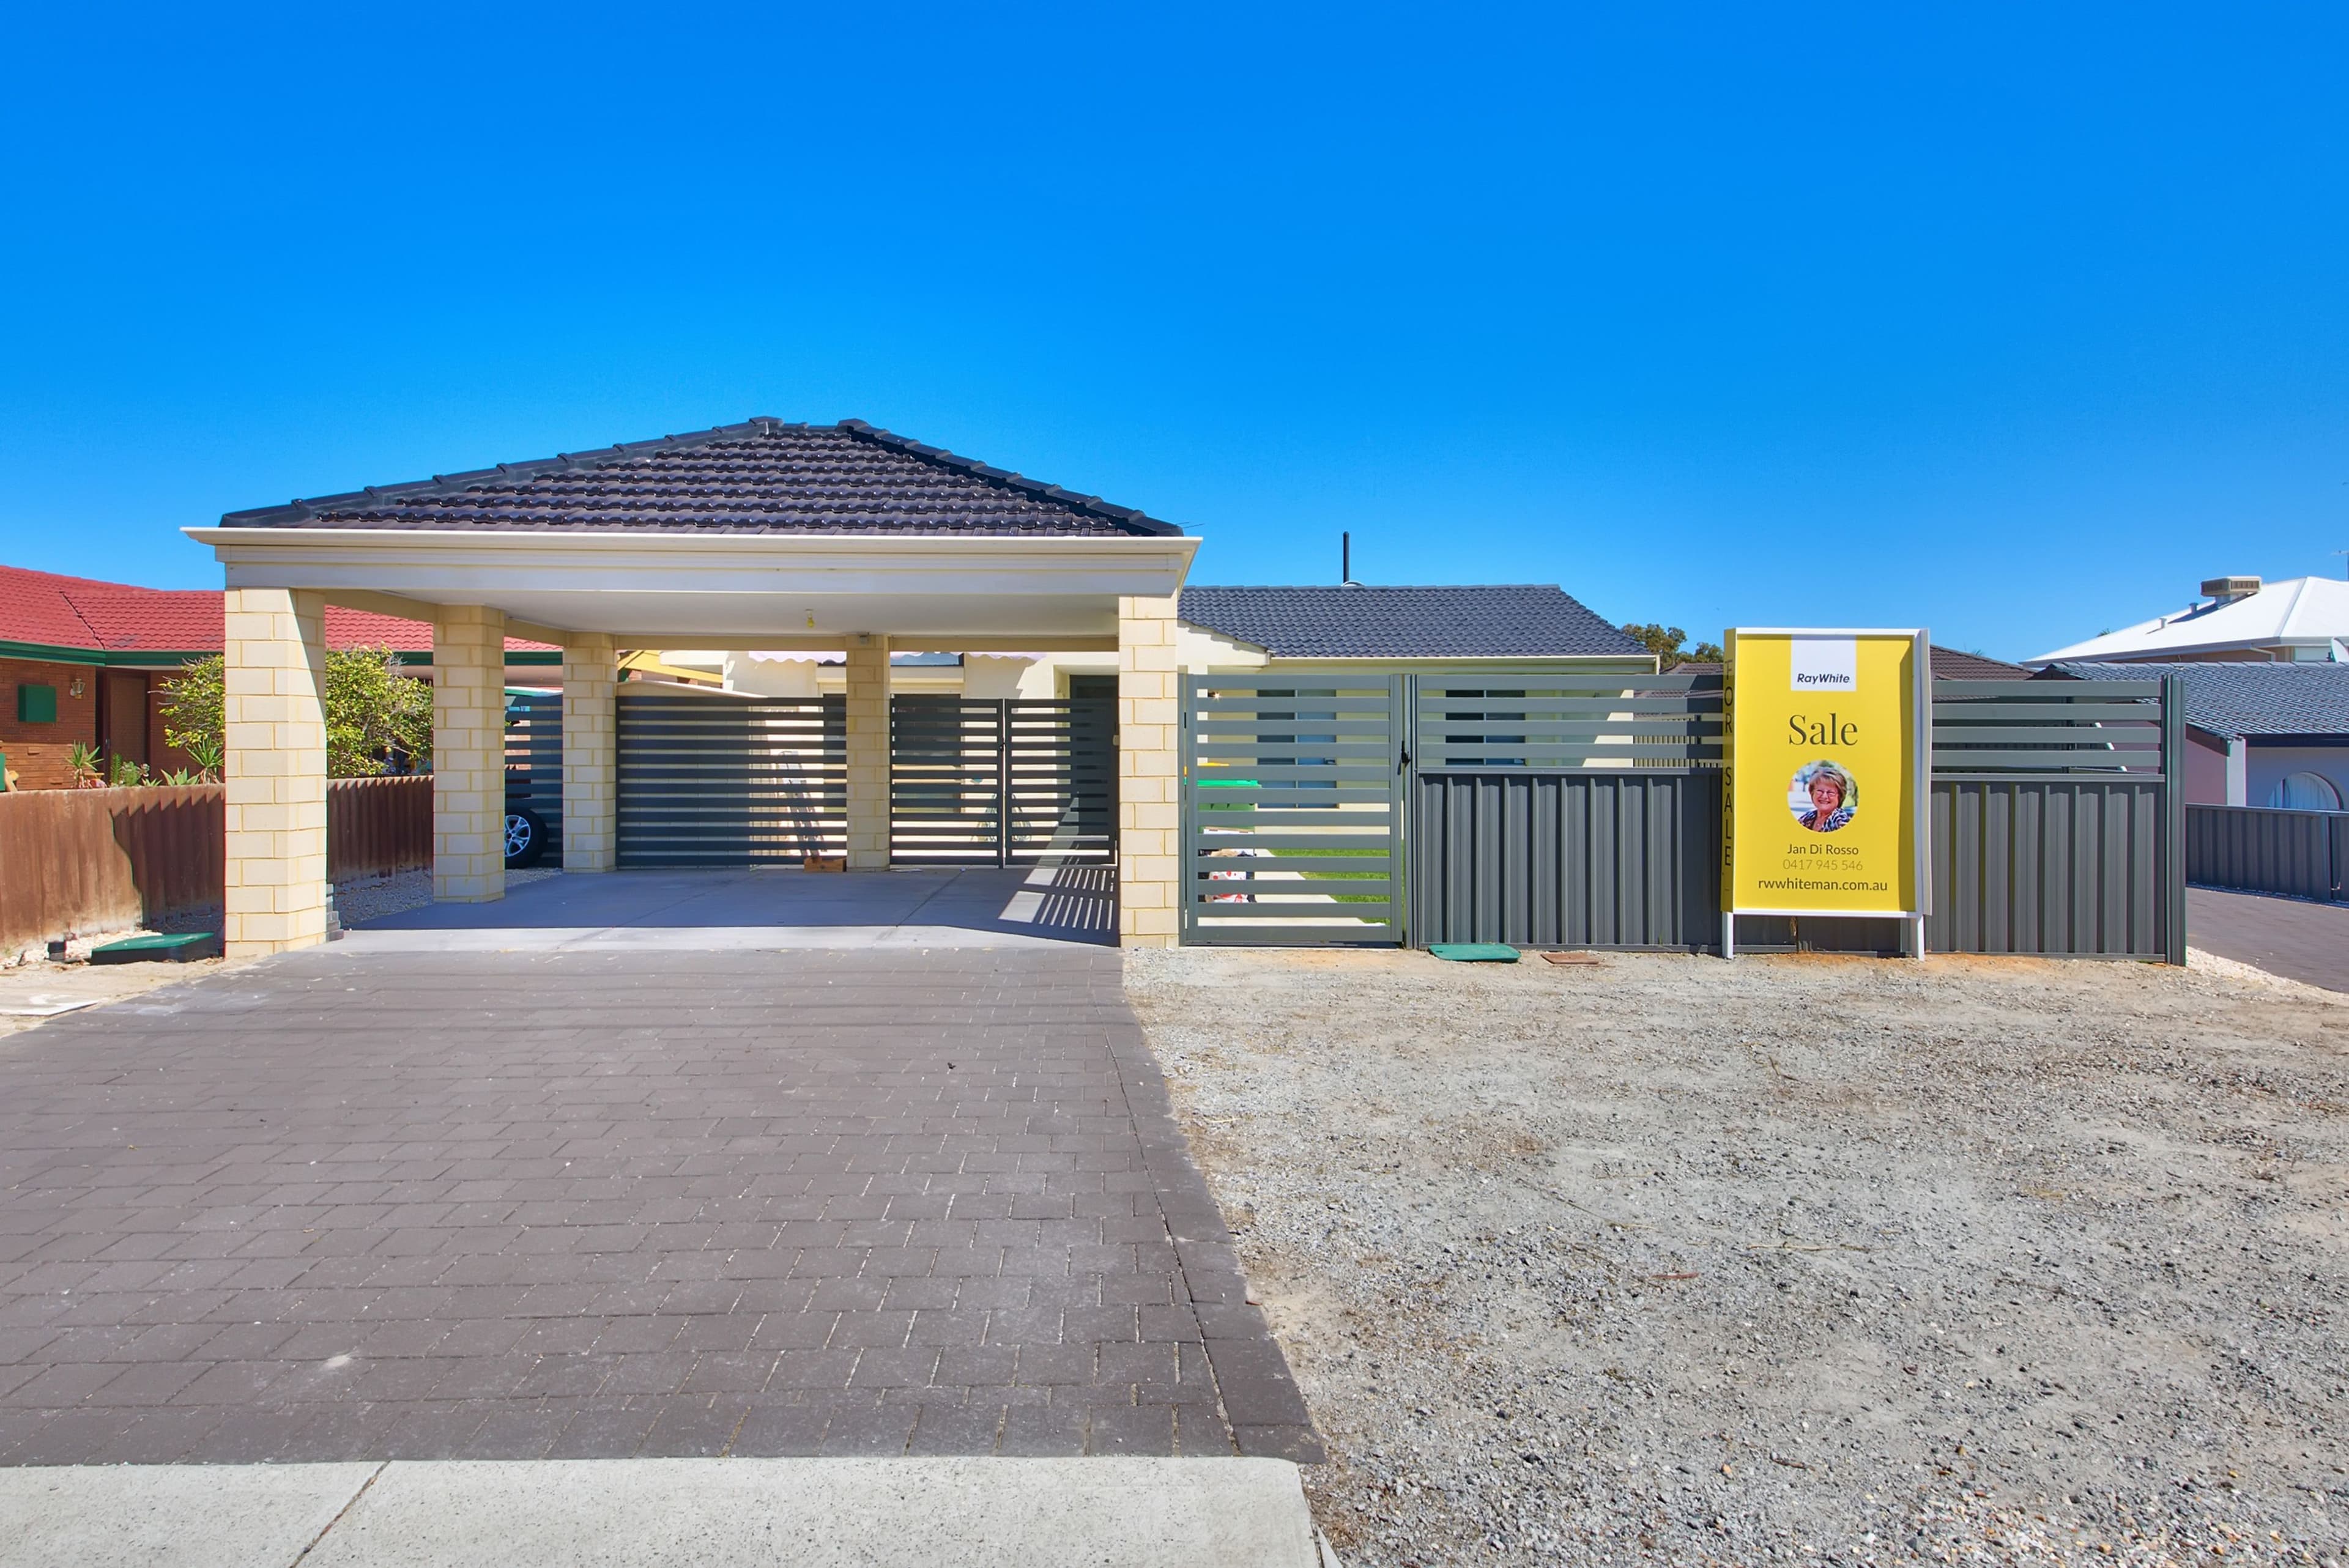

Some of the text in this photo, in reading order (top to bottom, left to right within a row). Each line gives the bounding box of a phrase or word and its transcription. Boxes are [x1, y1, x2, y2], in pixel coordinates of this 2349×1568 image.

[1789, 712, 1858, 746] Sale
[1724, 659, 1733, 866] FOR SALE
[1787, 844, 1860, 855] Jan Di Rosso
[1783, 859, 1863, 871] 0417 945 546
[1758, 878, 1888, 891] rwwhiteman.com.au
